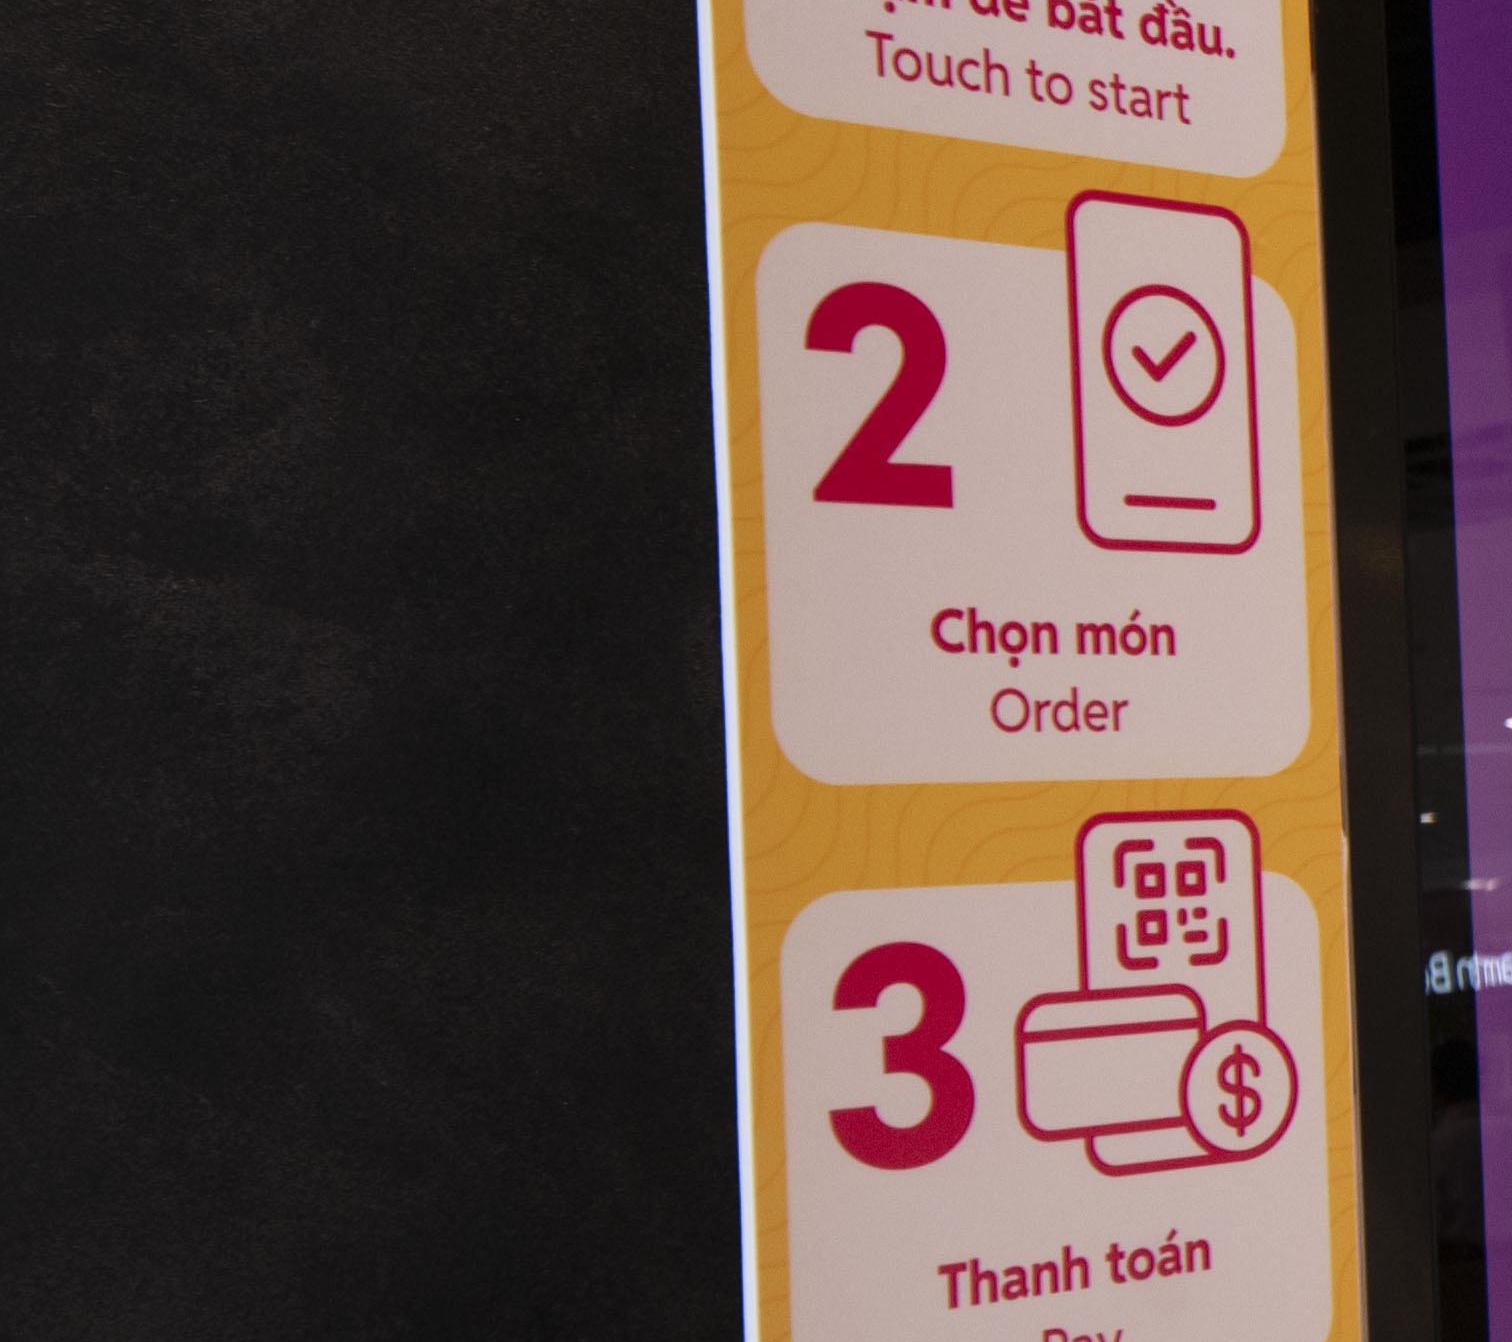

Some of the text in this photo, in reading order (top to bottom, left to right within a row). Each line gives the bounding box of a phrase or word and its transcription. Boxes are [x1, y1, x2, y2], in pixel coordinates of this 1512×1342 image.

[865, 29, 1191, 125] Touch to start
[804, 280, 954, 509] 2
[931, 607, 1176, 667] Chọn món
[990, 687, 1128, 733] Order
[829, 941, 975, 1170] 3
[938, 1229, 1212, 1310] Thanh toán
